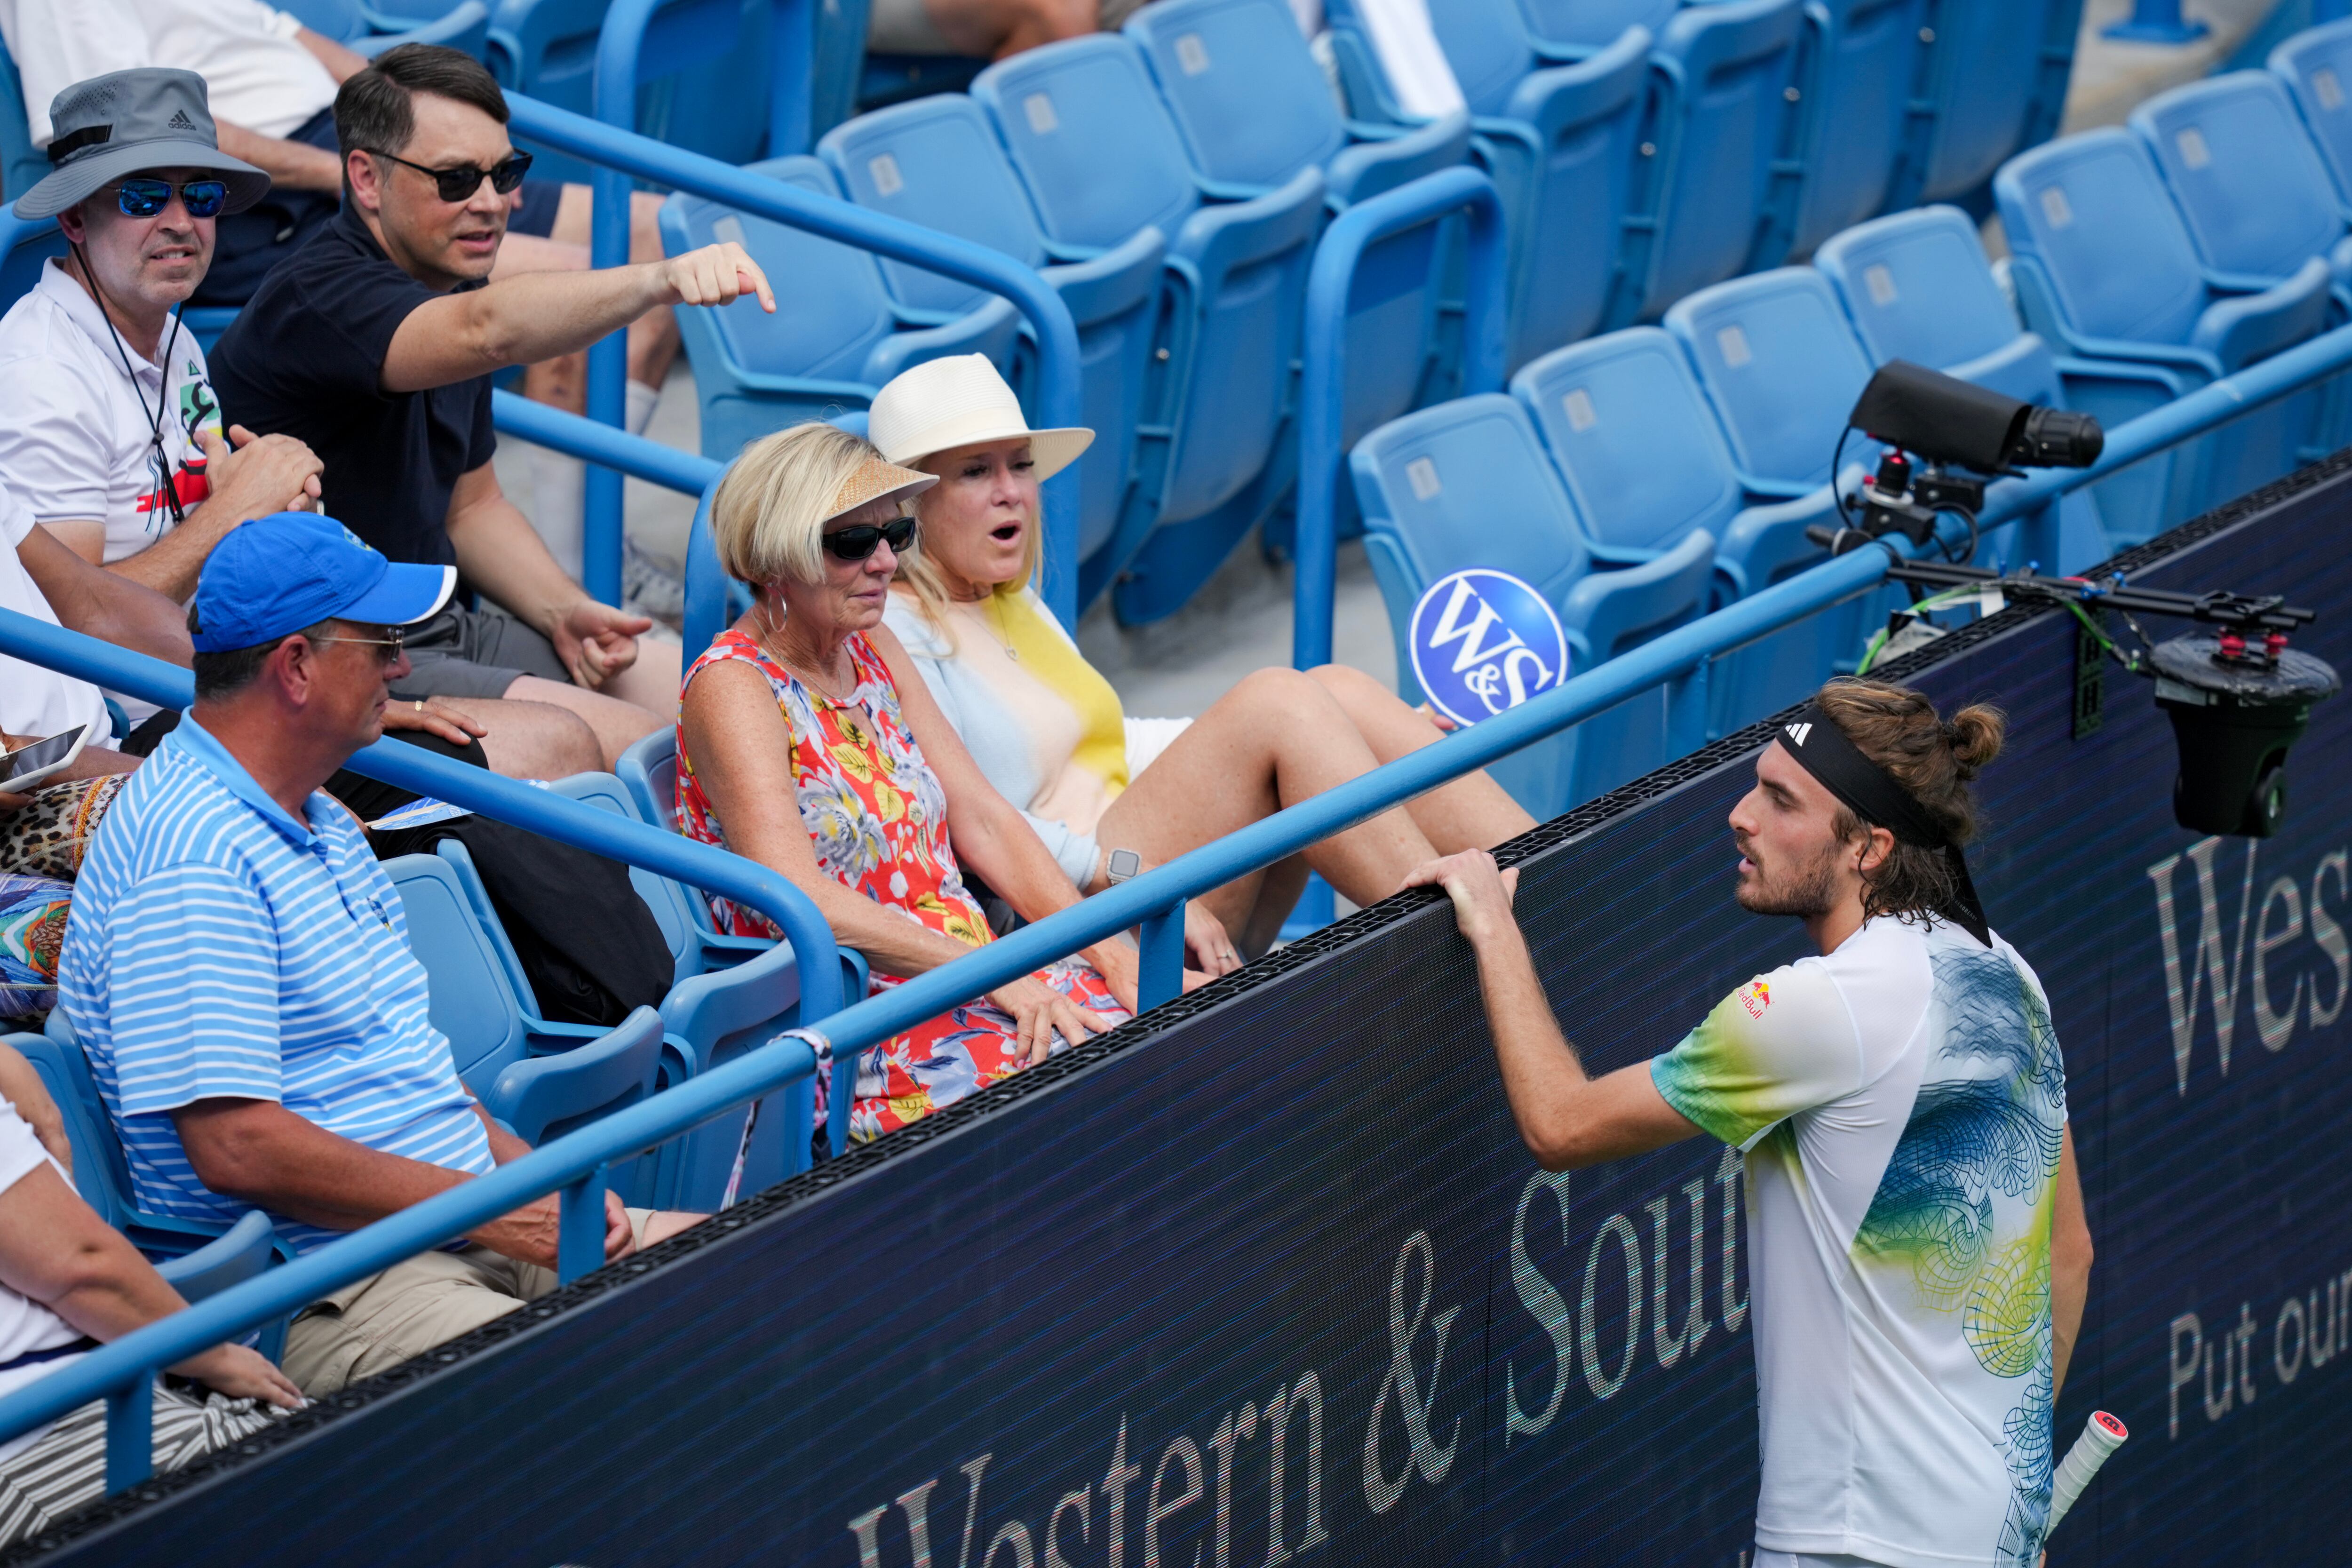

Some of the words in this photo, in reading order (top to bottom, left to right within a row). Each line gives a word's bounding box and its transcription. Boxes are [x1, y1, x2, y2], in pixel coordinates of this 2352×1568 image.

[168, 121, 197, 131] adidas
[2146, 835, 2350, 1098] Wes
[848, 1369, 1329, 1568] tern
[1363, 1229, 1462, 1514] &
[2169, 1301, 2257, 1441] Put
